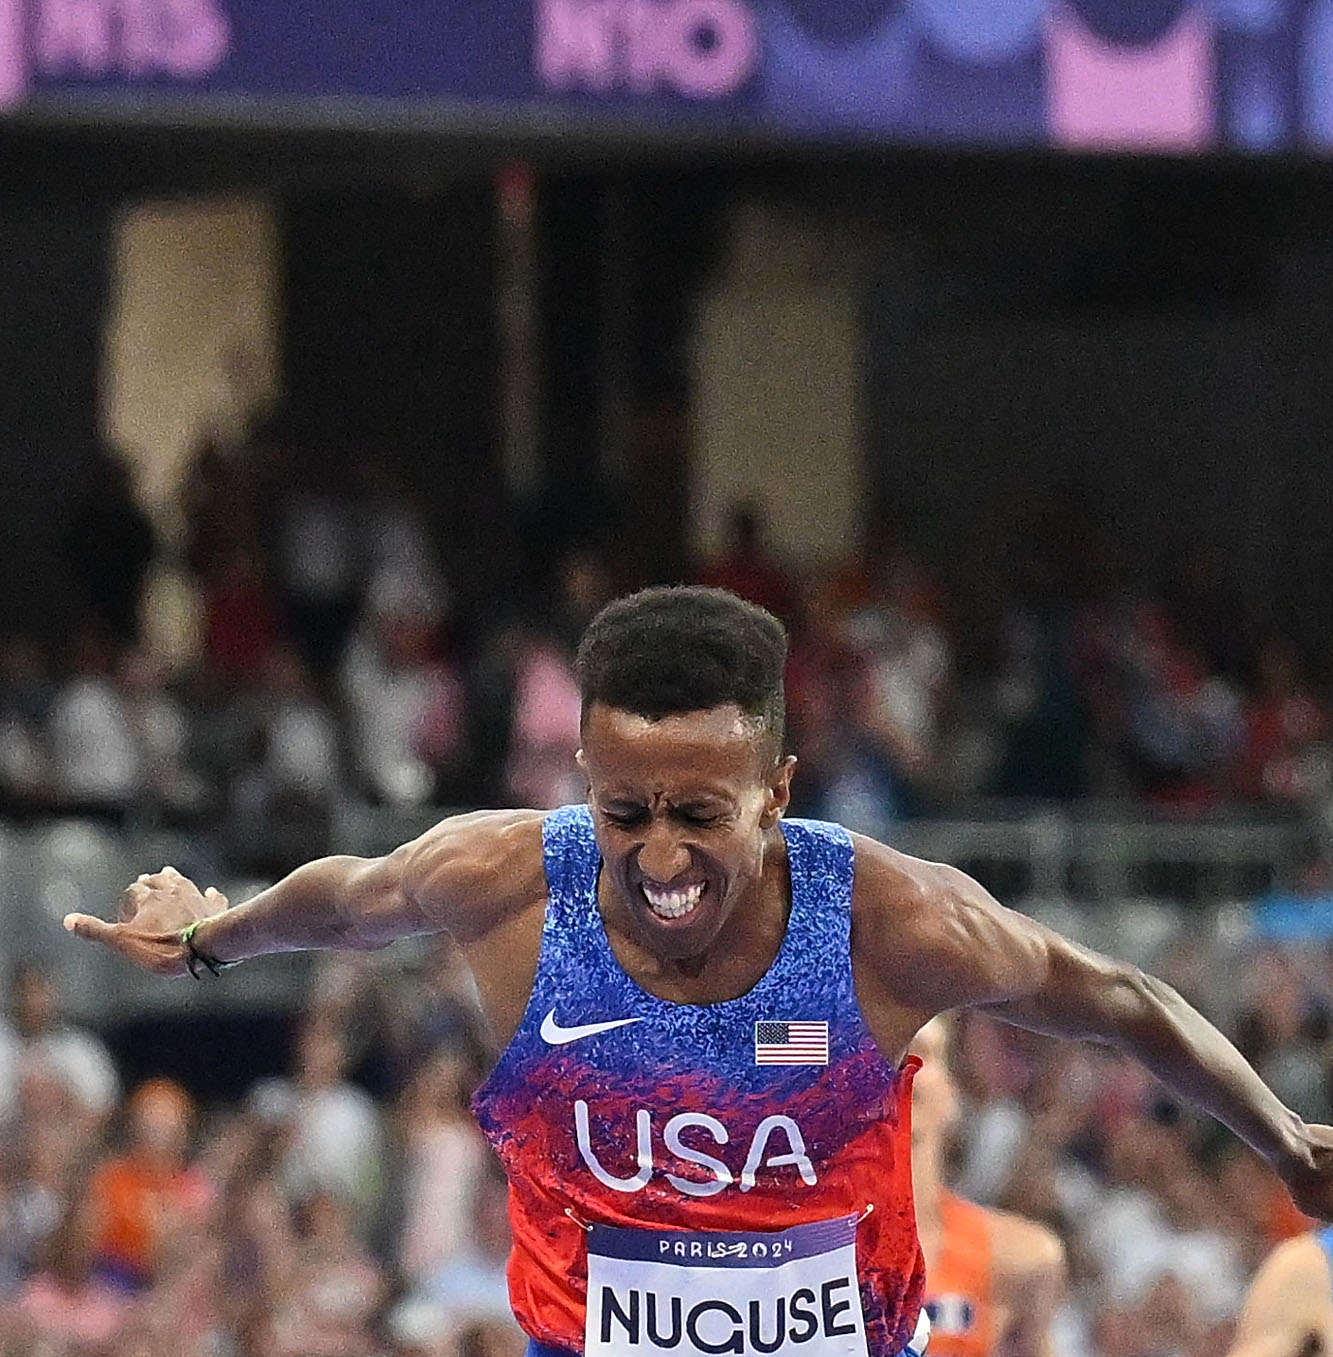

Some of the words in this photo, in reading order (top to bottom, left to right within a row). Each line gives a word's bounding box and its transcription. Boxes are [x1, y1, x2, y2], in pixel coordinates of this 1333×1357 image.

[574, 1099, 817, 1197] USA
[659, 1239, 727, 1259] PARIS
[736, 1238, 793, 1259] 2024
[599, 1277, 857, 1355] NUGUSE
